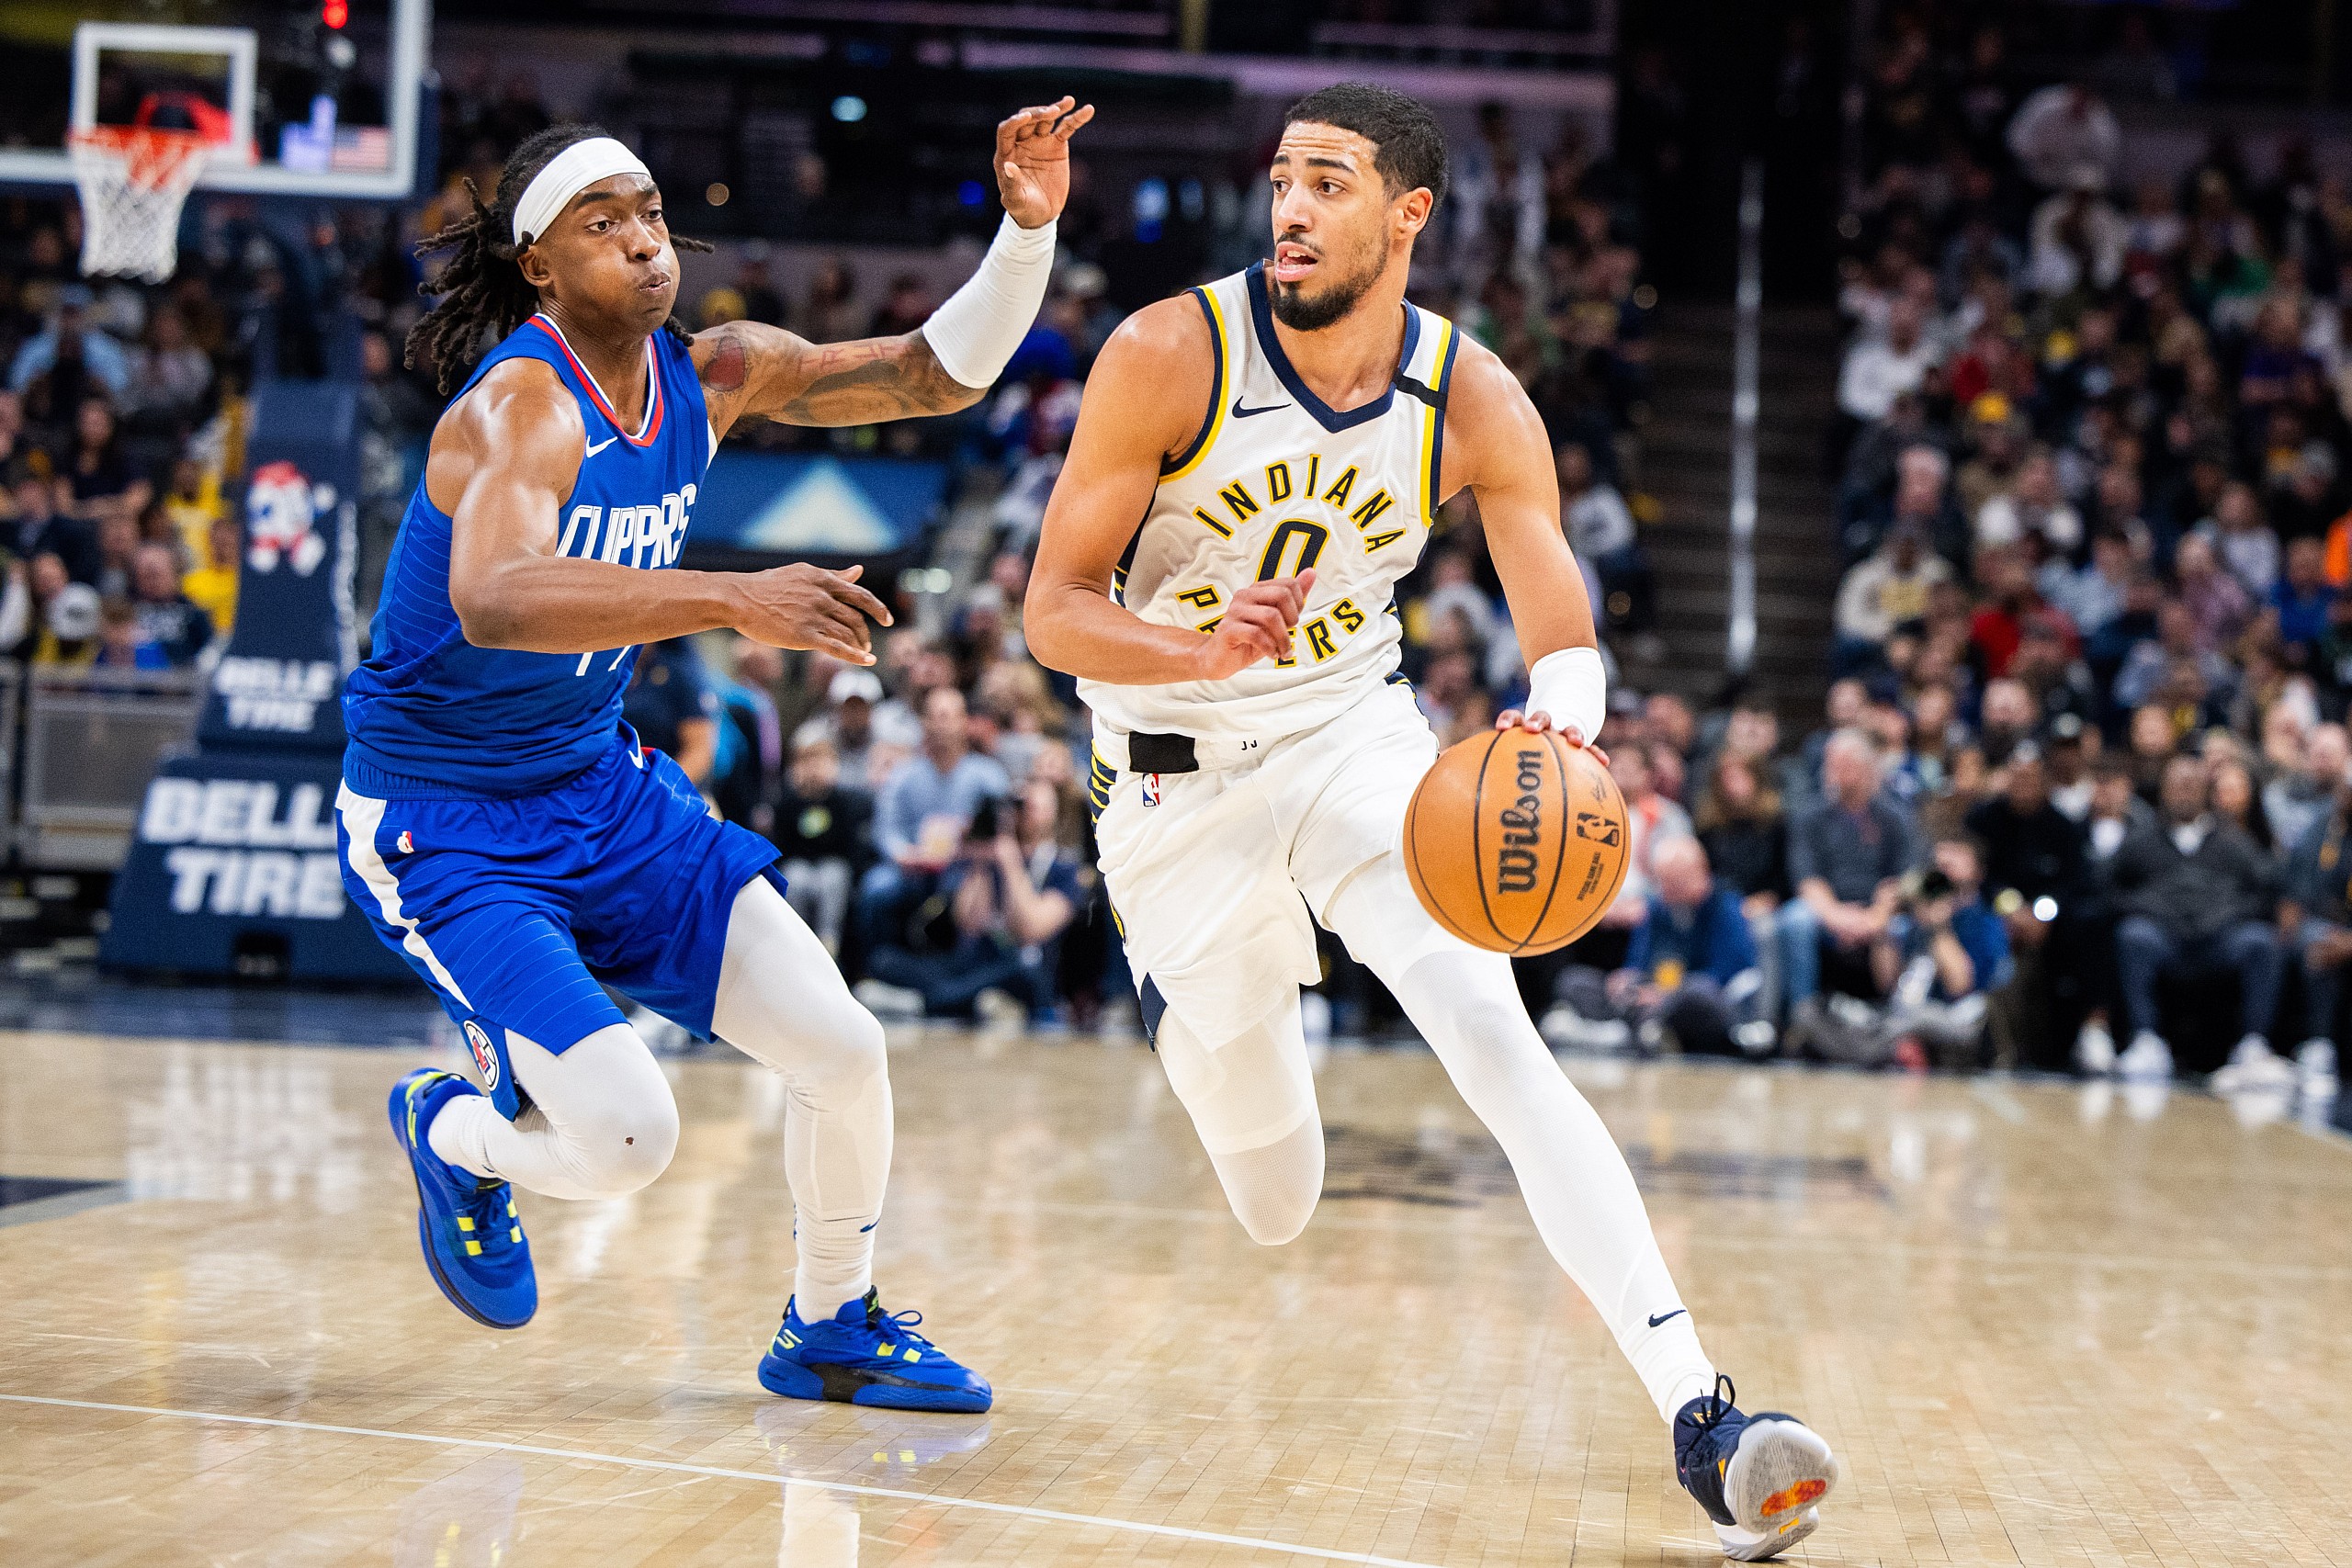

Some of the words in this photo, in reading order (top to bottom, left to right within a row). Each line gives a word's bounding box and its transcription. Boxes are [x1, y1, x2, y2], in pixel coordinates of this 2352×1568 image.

[555, 483, 696, 570] CLIPPRS
[1193, 454, 1407, 555] INDIANA
[1255, 518, 1330, 584] 0
[1175, 584, 1367, 669] PRS
[216, 656, 335, 702] BELLE
[229, 695, 316, 732] TIRE
[142, 777, 338, 847] BELL
[1498, 750, 1544, 895] Wilson
[166, 847, 345, 919] TIRE
